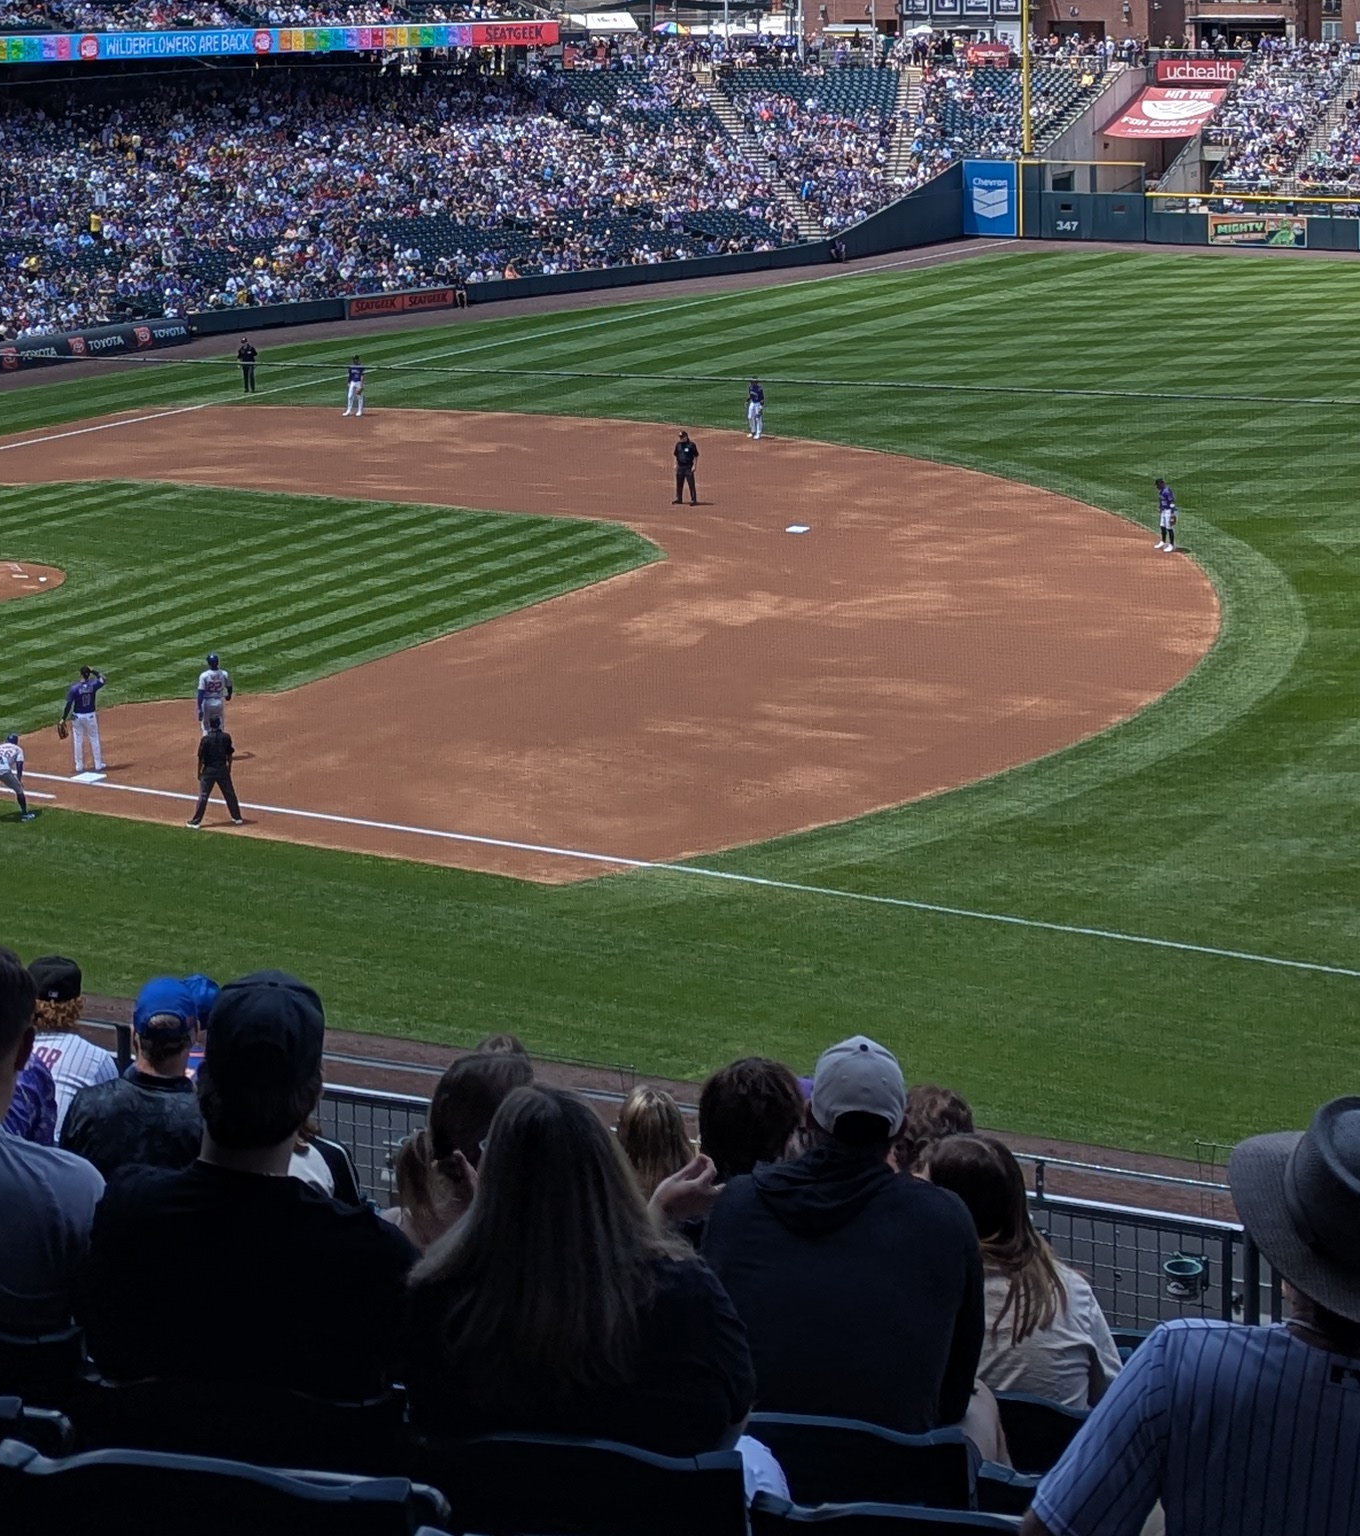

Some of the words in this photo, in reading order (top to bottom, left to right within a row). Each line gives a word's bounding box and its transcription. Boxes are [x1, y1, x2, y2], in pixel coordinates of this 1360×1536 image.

[485, 23, 544, 42] SEATGEEK
[105, 35, 196, 56] WILDERFLOWERS
[198, 35, 219, 54] ARE
[221, 33, 250, 52] BACK
[1166, 61, 1237, 79] uchealth
[1164, 90, 1188, 100] HIT
[1189, 90, 1214, 100] THE
[1120, 116, 1148, 126] FOR
[1149, 117, 1206, 127] CHARITY
[972, 177, 1008, 186] Chevron
[1056, 220, 1079, 231] 347
[1217, 222, 1263, 234] MIGHTY
[355, 297, 397, 312] SEATGEEK
[408, 292, 448, 307] SEATGEEK
[152, 325, 187, 340] TOYOTA
[87, 335, 125, 351] TOYOTA
[207, 681, 223, 692] 22
